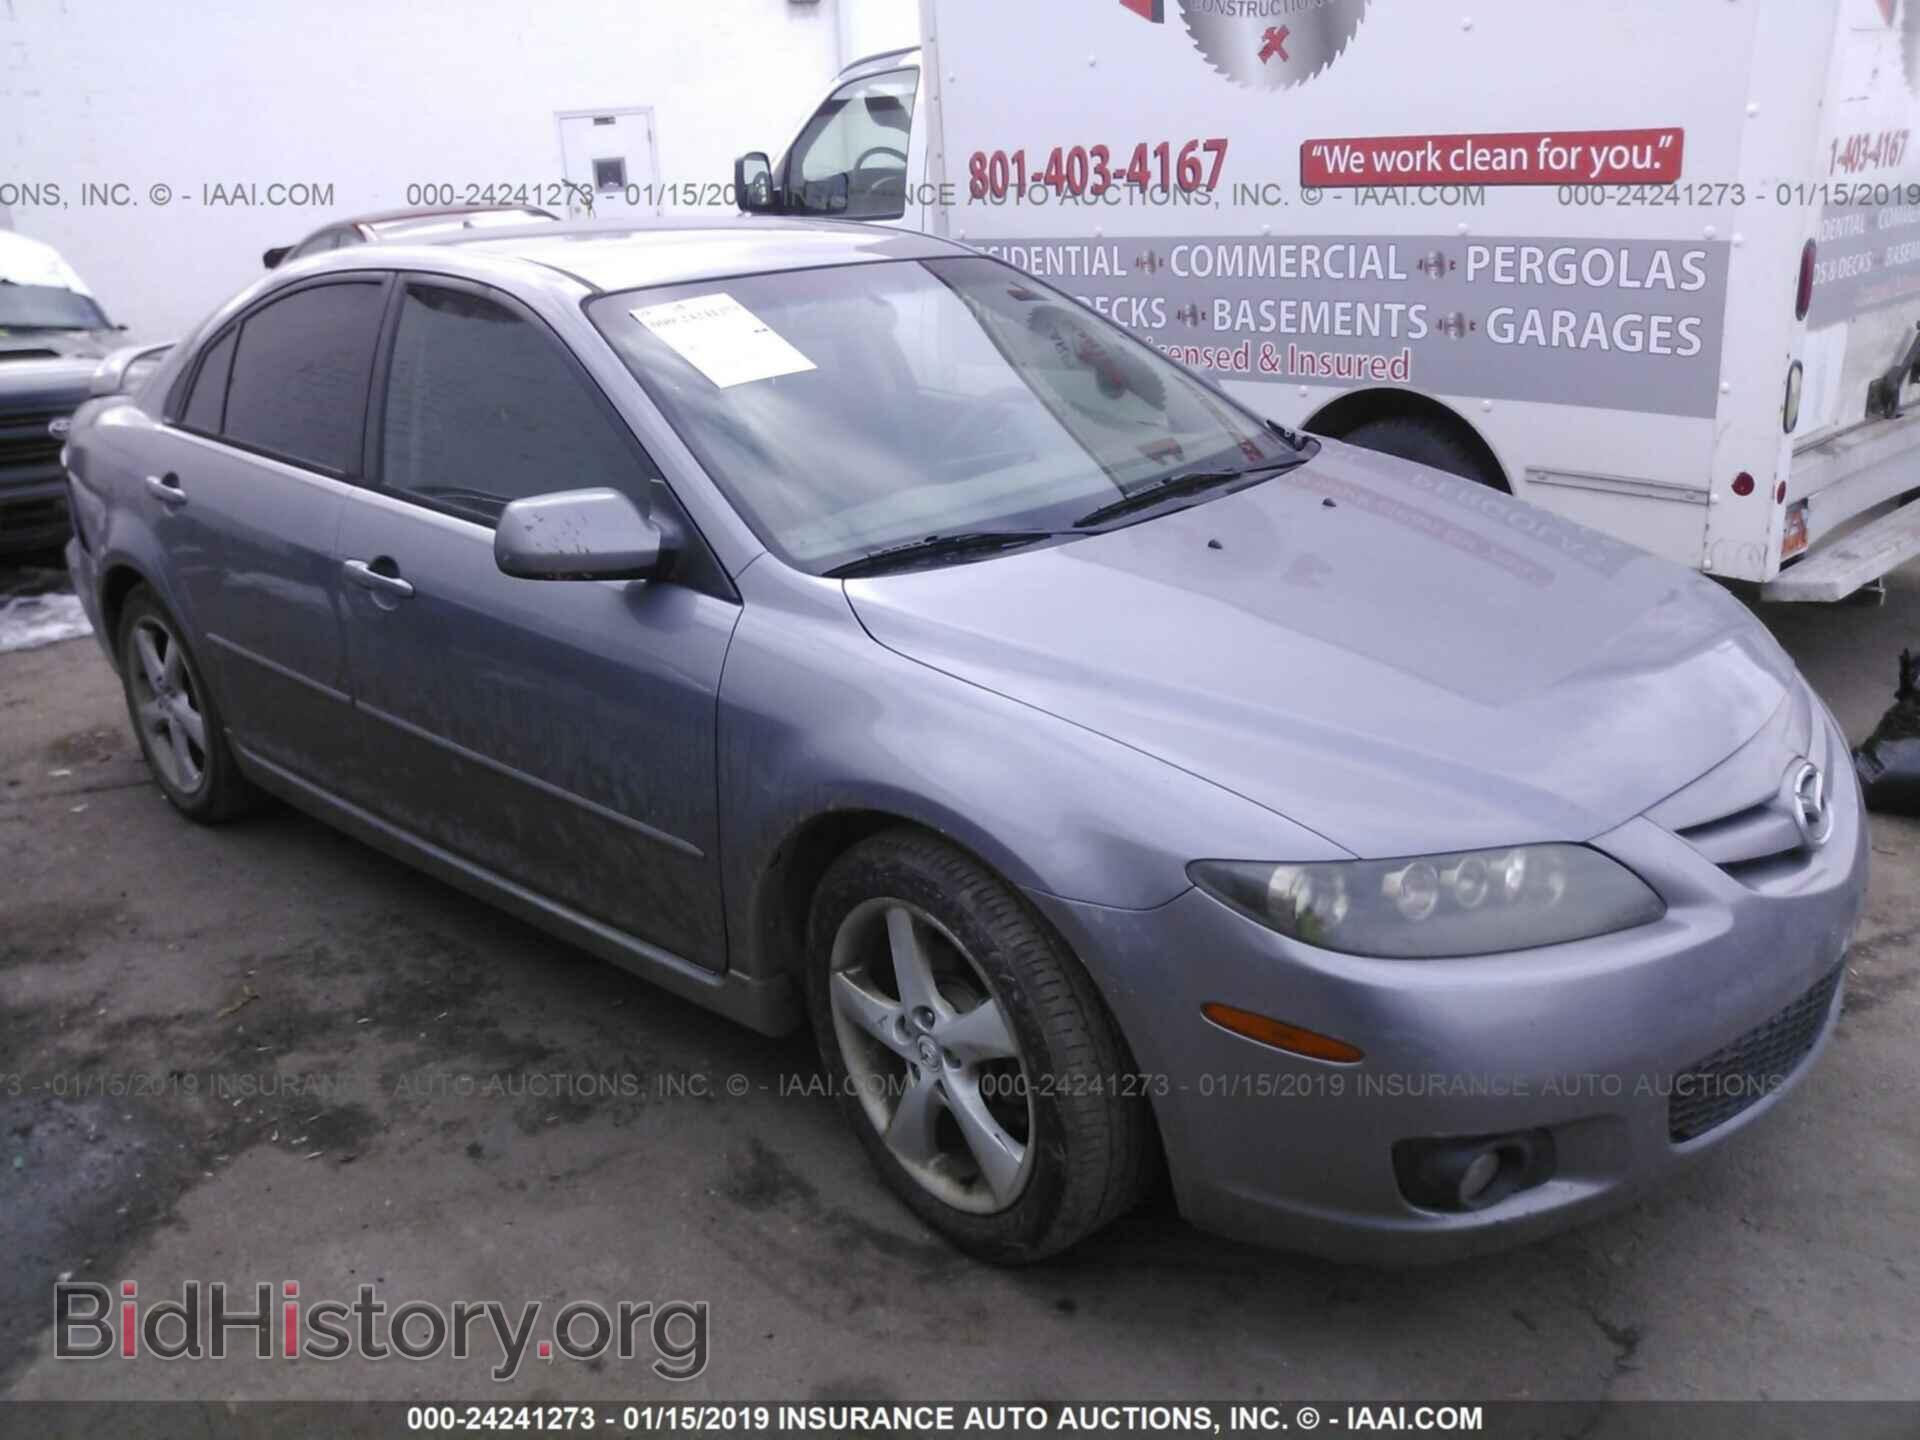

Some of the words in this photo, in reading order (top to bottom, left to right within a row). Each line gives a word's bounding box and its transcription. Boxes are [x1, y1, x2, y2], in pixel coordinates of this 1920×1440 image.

[969, 138, 1229, 198] 801-403-4167
[1372, 141, 1442, 172] work
[1450, 141, 1528, 171] clean
[1536, 138, 1583, 171] for
[976, 246, 1127, 276] IDENTIAL
[1170, 244, 1408, 281] COMMERCIAL
[1466, 245, 1707, 291] PERGOLAS
[1075, 296, 1167, 328] ECKS
[1213, 299, 1428, 340] BASEMENTS
[1486, 306, 1702, 357] GARAGES
[1147, 335, 1250, 371] ensed
[1259, 341, 1282, 374] &
[1287, 342, 1411, 382] Insured
